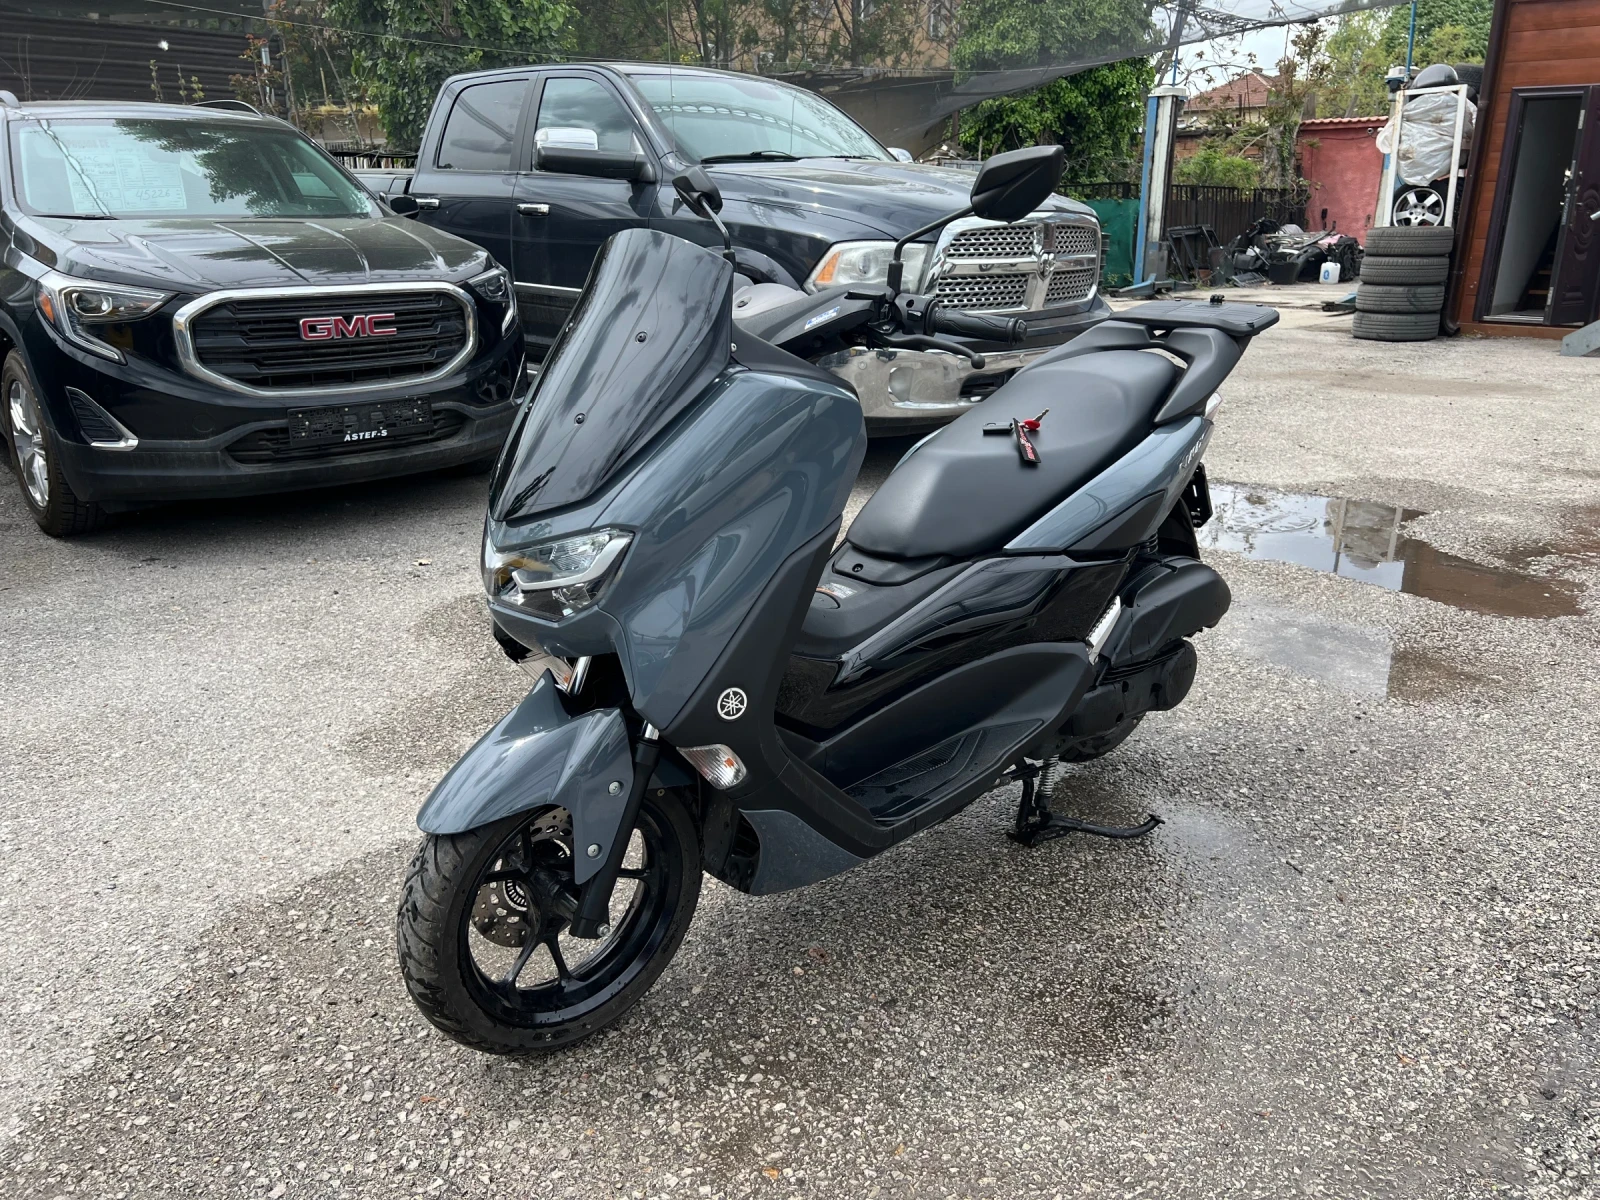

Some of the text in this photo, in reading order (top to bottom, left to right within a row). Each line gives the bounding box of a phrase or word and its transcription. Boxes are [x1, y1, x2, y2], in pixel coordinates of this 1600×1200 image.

[135, 188, 171, 201] 45226
[299, 312, 398, 341] GMC
[343, 429, 388, 442] ASTEF-S
